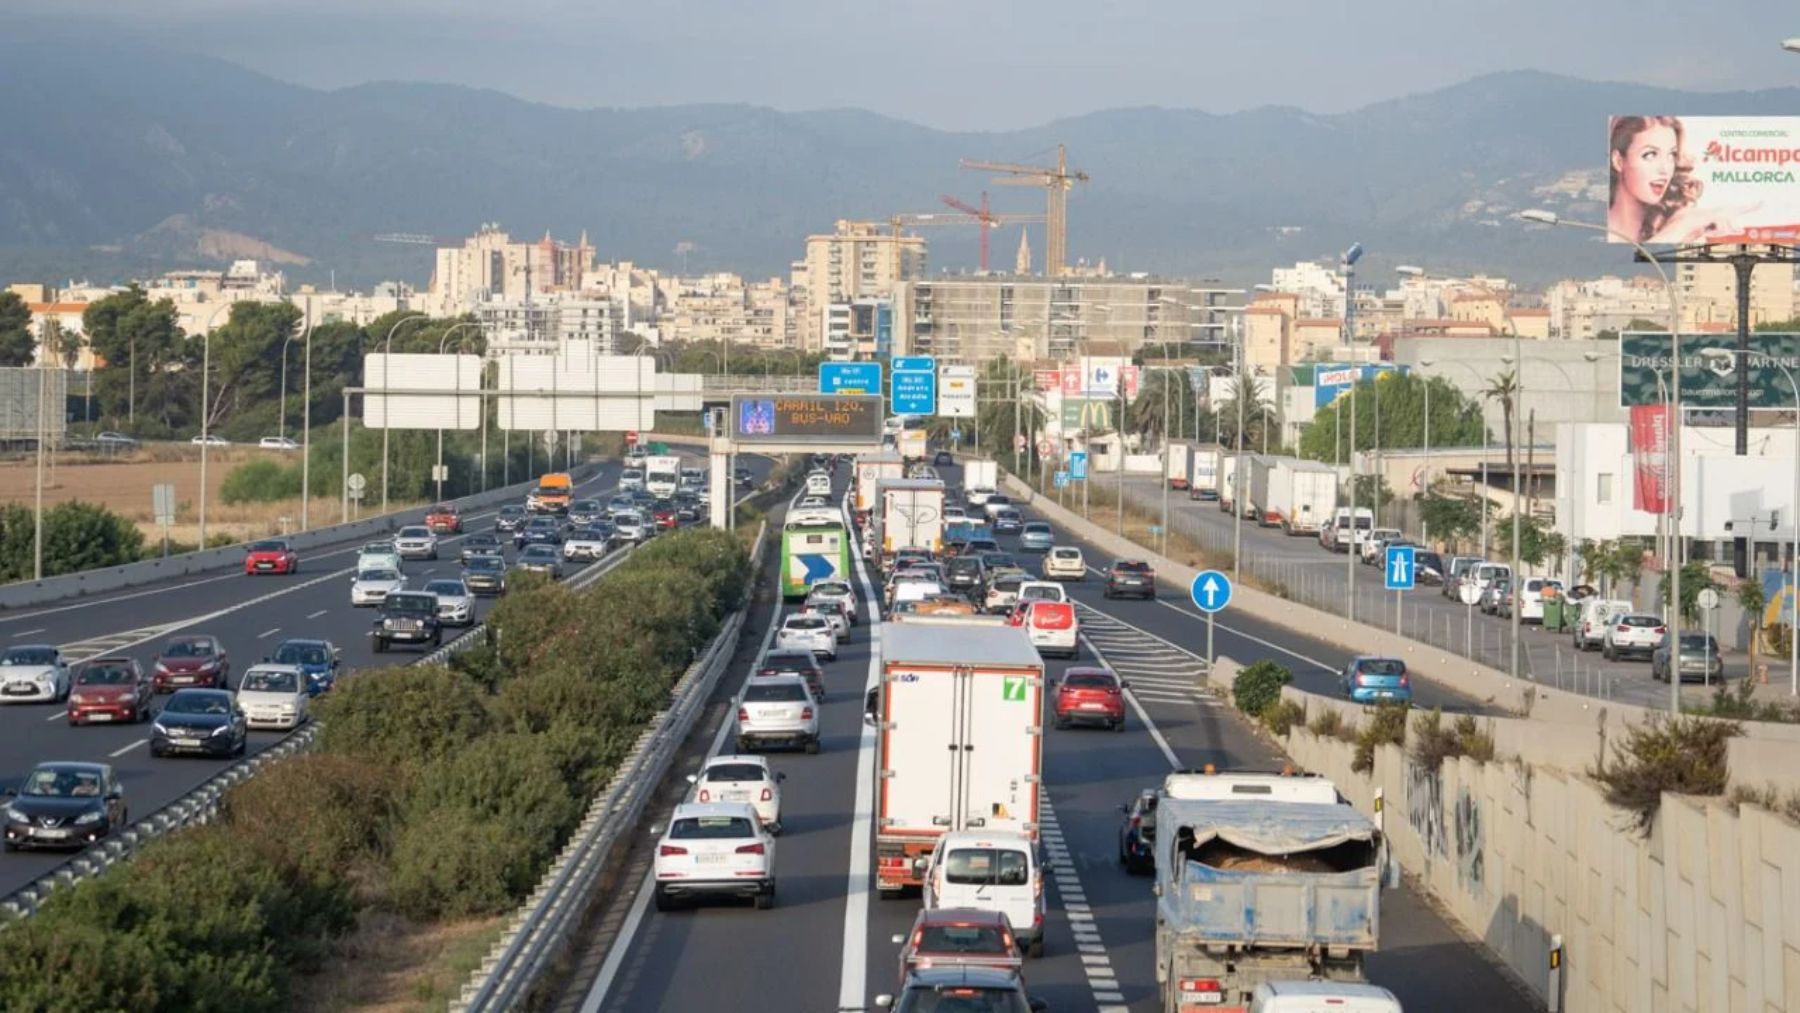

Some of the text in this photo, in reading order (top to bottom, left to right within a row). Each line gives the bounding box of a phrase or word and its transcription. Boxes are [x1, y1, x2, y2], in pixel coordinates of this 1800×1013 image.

[1703, 141, 1800, 166] Alcampo
[1712, 171, 1795, 183] MALLORCA
[1006, 677, 1023, 699] 7
